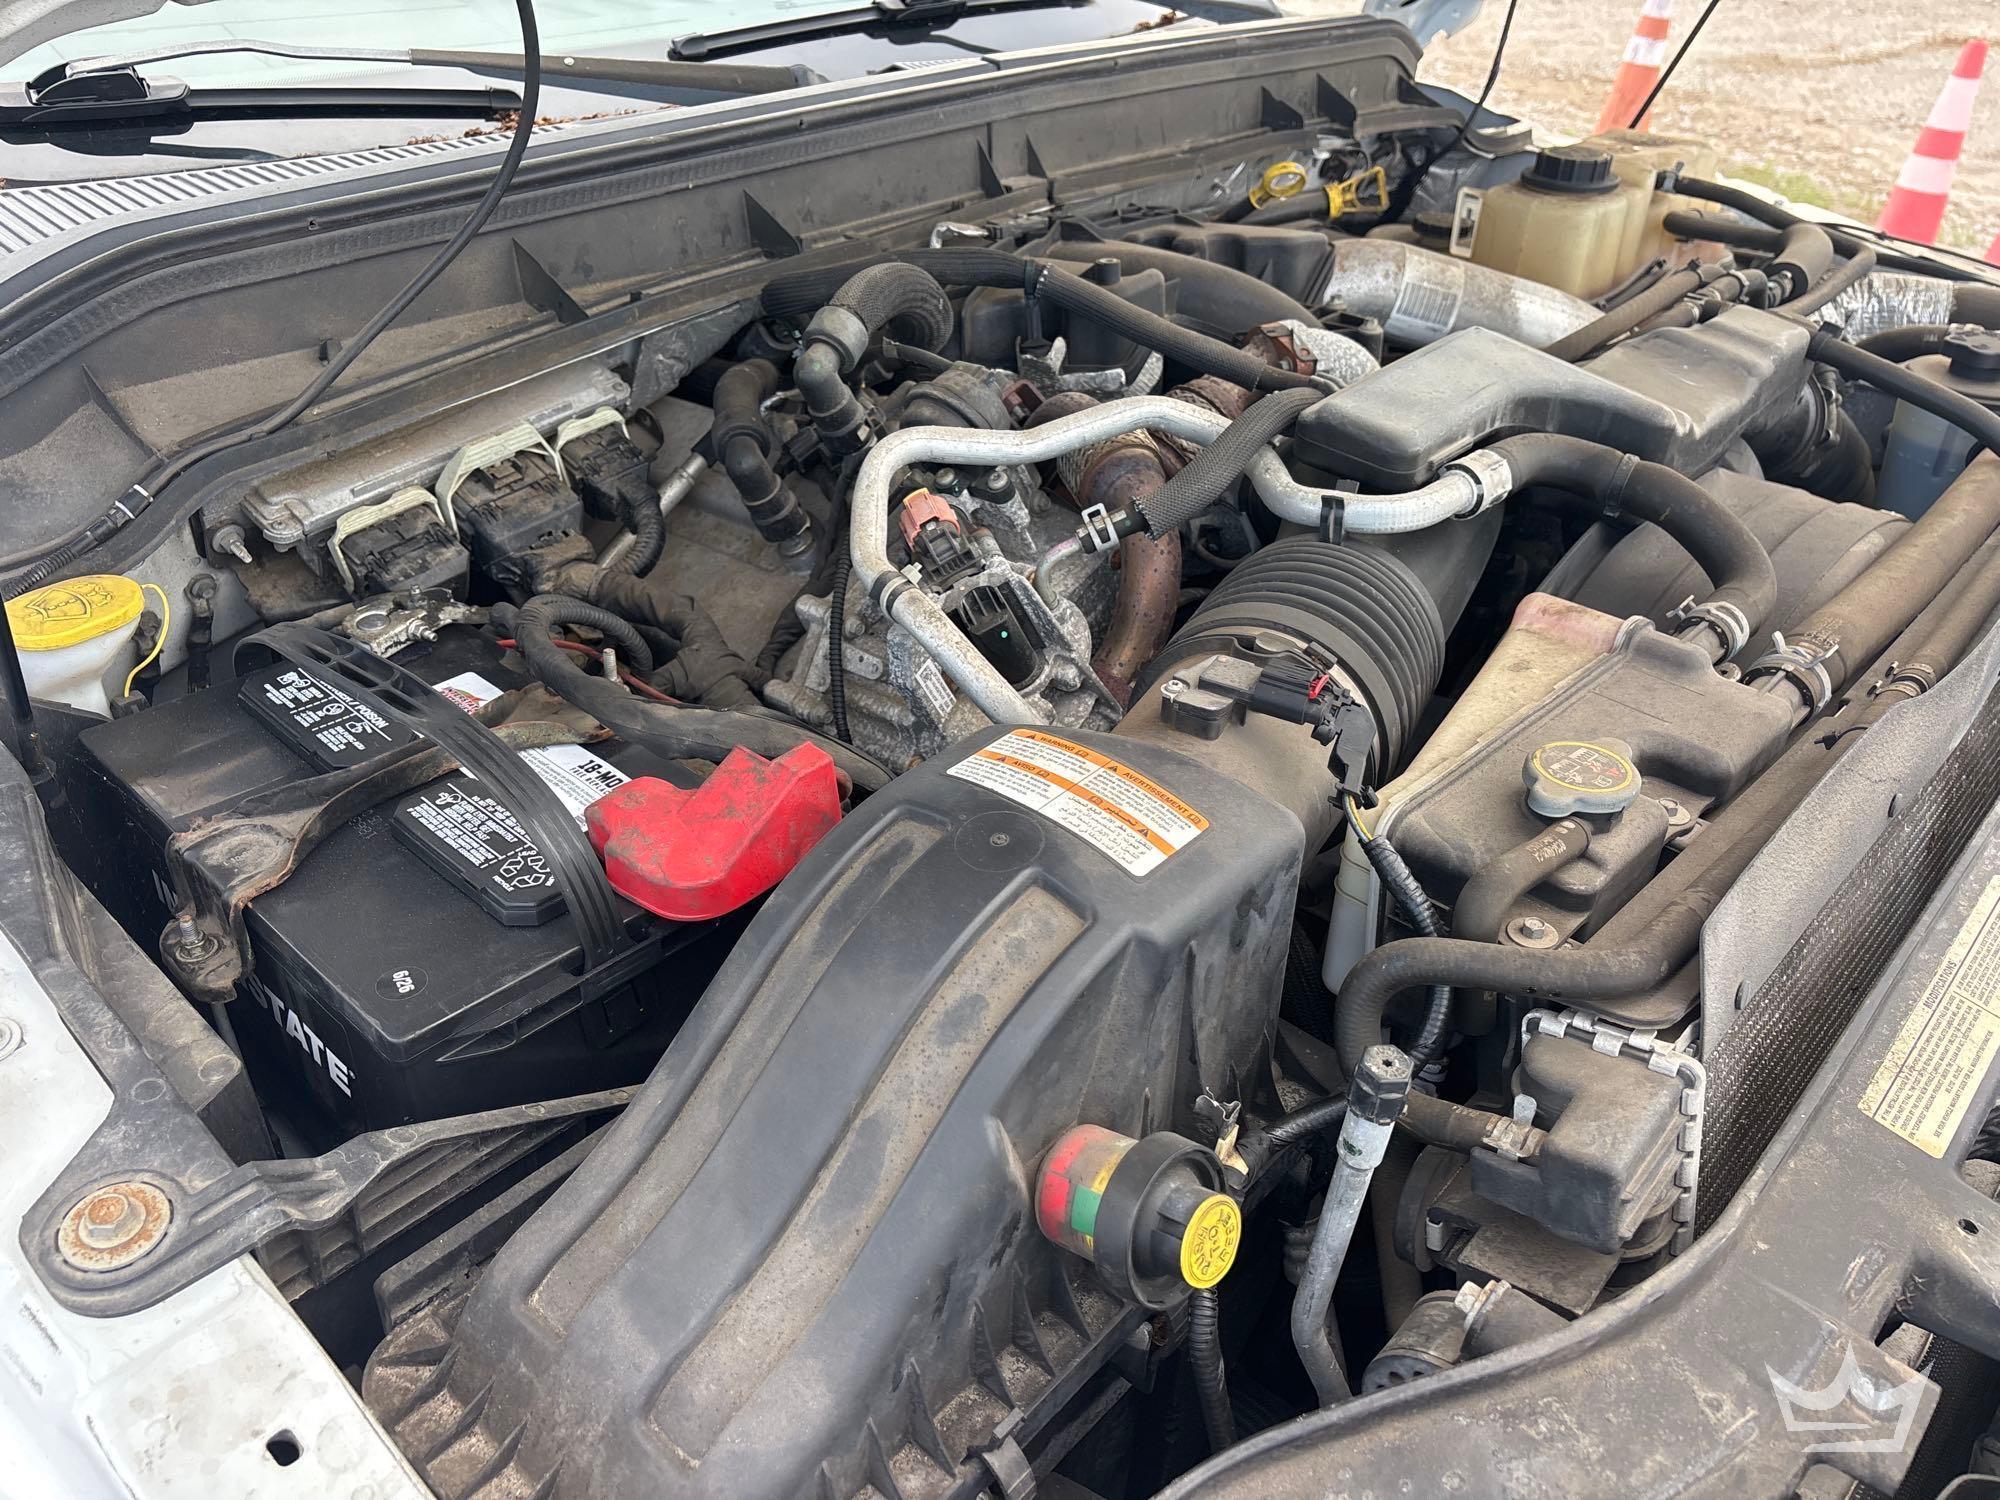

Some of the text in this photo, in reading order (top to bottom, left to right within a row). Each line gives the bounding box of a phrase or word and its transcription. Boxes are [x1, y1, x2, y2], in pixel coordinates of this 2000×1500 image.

[1039, 737, 1075, 752] WARNING
[1012, 760, 1036, 771] AVISO
[1123, 772, 1188, 814] AVERTISSEMENT
[392, 970, 415, 993] 6/26
[1923, 961, 1957, 1009] MODIFICATIONS
[1194, 1226, 1211, 1275] PUSH
